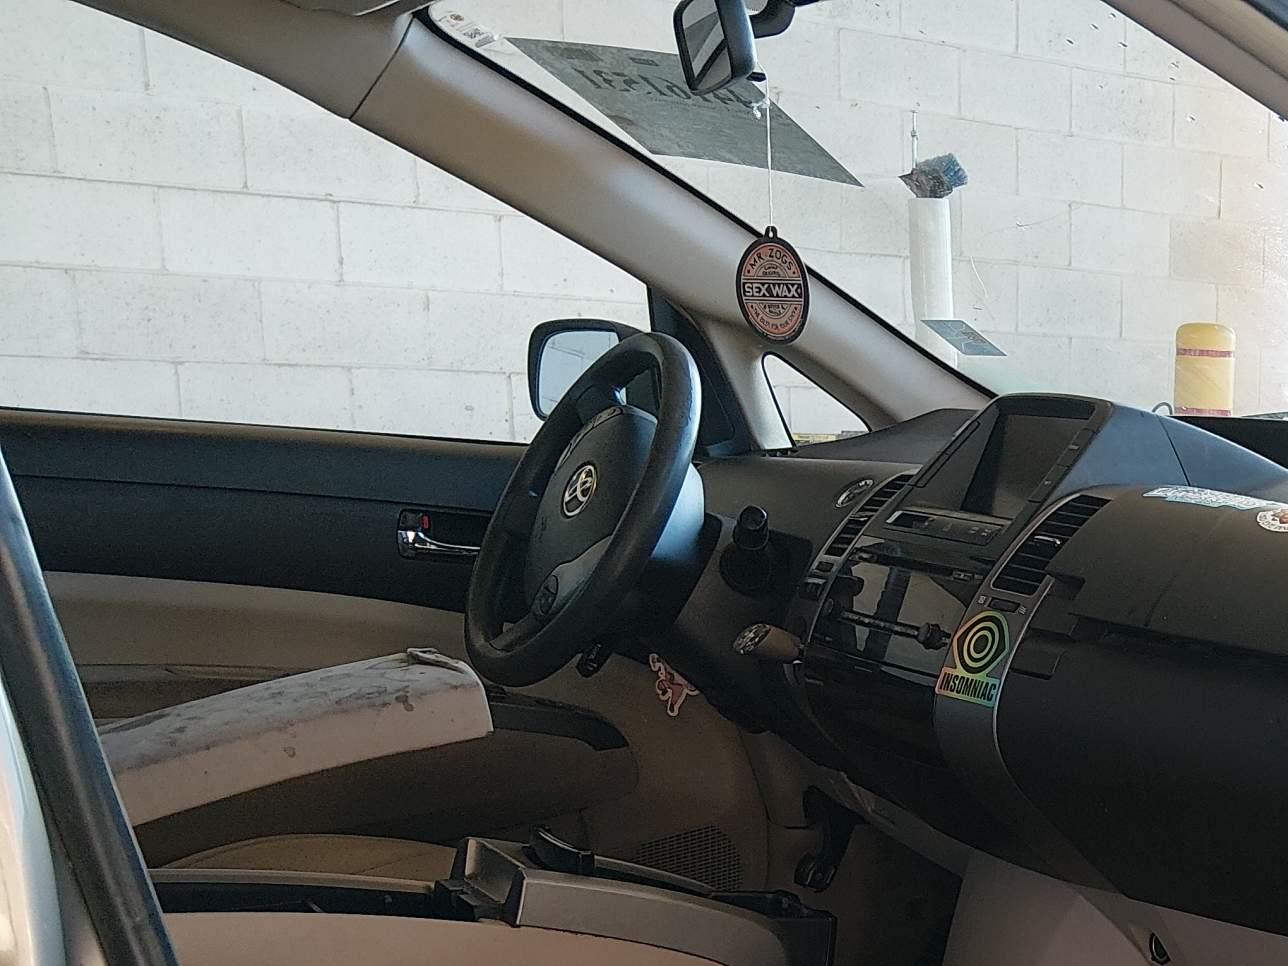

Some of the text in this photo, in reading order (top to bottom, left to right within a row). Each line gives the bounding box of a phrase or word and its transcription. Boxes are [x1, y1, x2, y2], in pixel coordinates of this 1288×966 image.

[749, 253, 765, 270] MR
[768, 248, 794, 271] ZOGS
[744, 283, 799, 298] SEX WAX
[939, 671, 997, 702] INSOMNIAC
